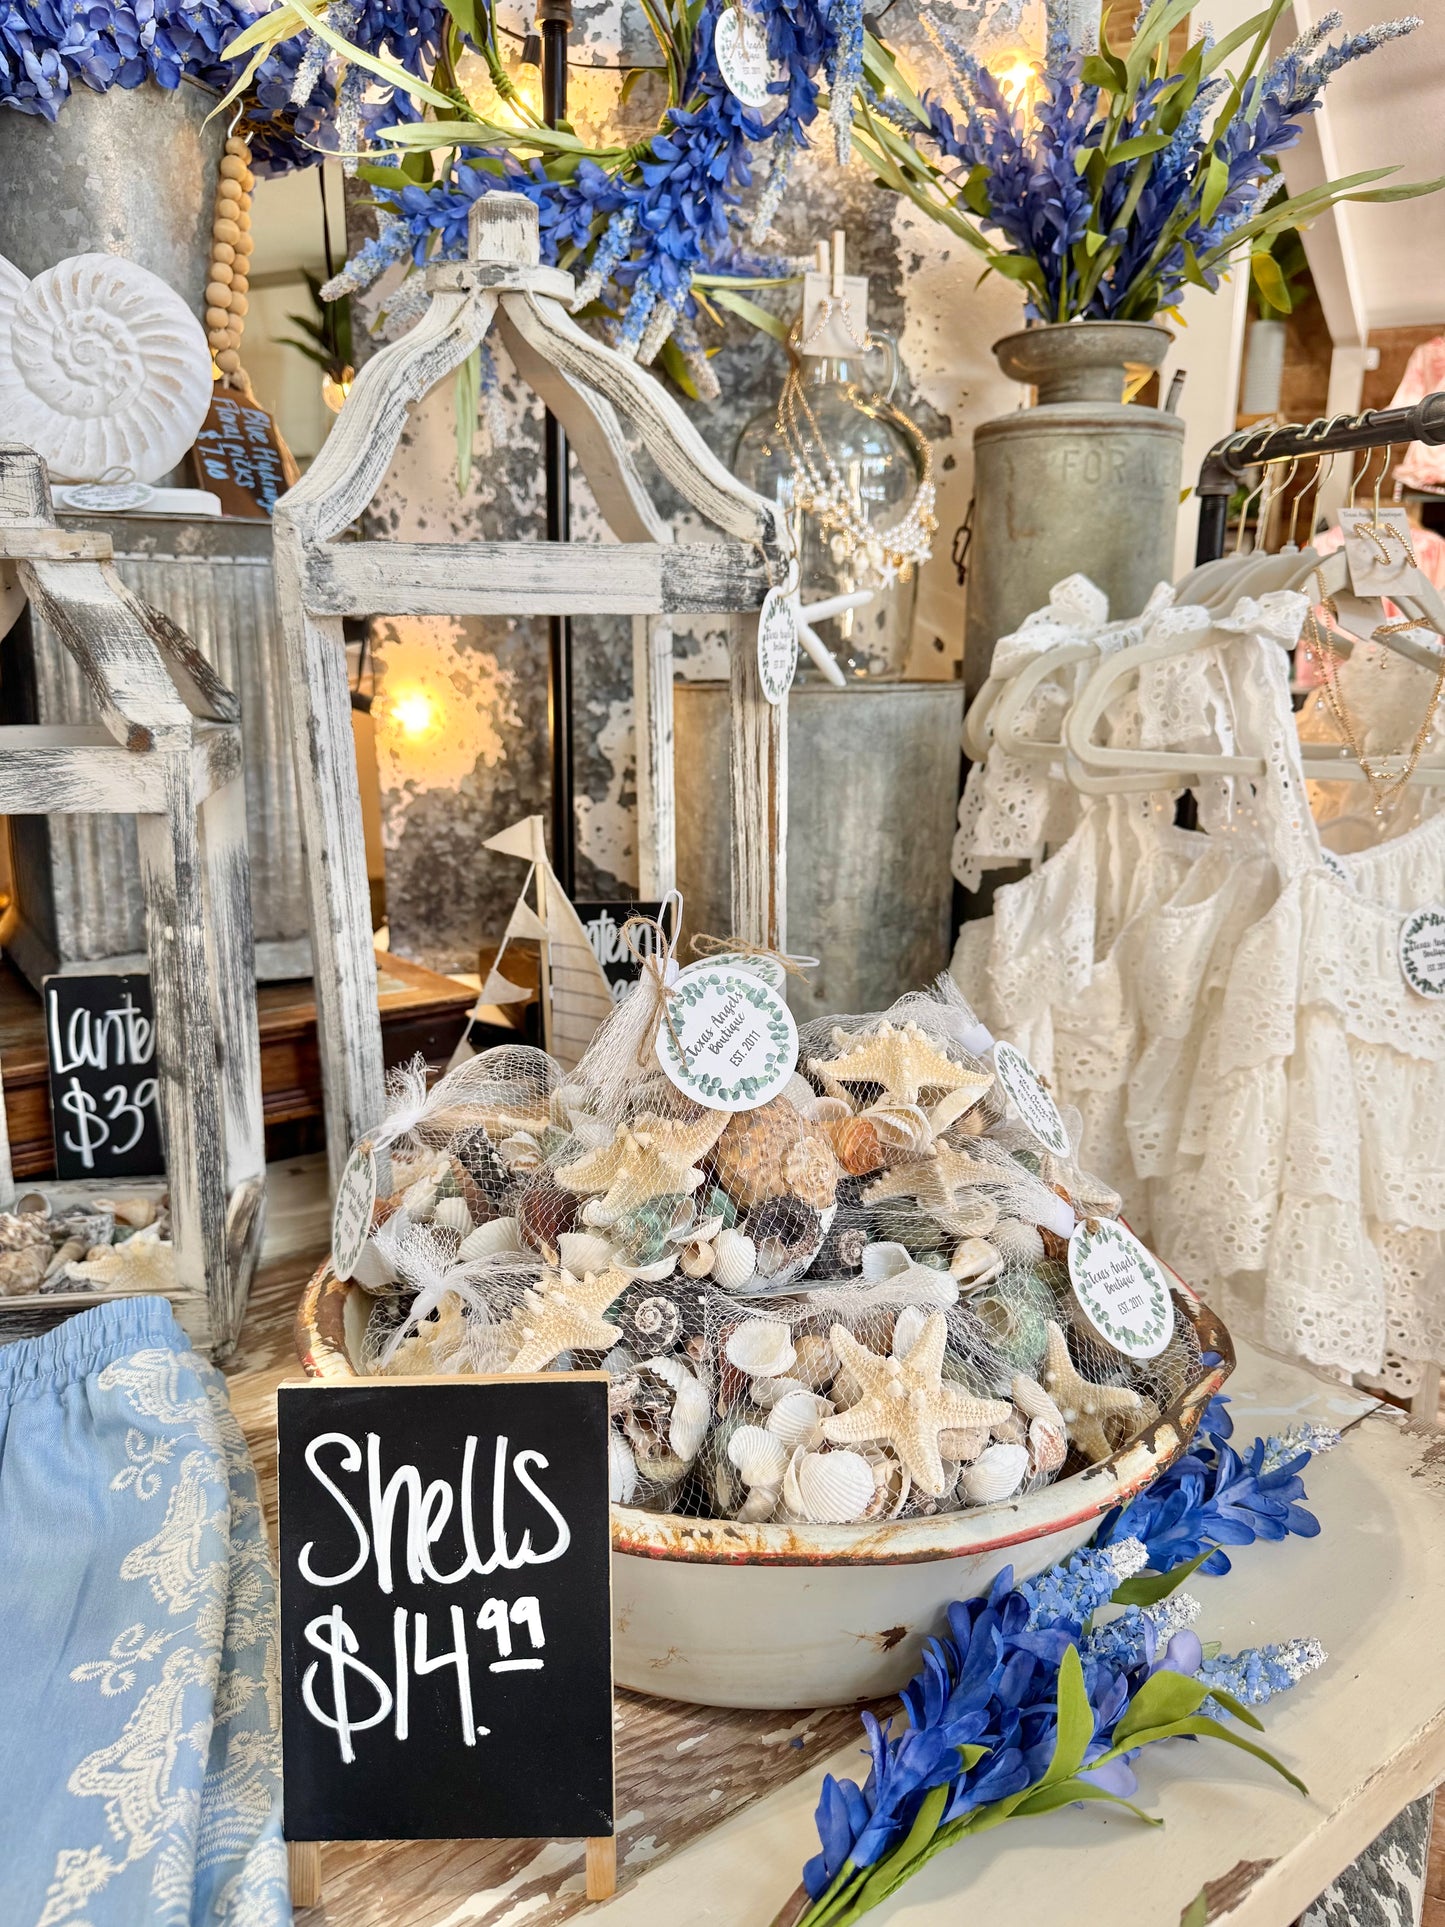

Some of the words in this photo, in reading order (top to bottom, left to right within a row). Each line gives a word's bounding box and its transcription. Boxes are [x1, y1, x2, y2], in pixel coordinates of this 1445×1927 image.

[211, 396, 245, 440] Floral
[241, 406, 271, 443] Blue
[49, 989, 157, 1074] Lante
[685, 1028, 714, 1058] Texas
[712, 991, 744, 1029] Angels
[708, 1011, 745, 1055] Boutique
[729, 1049, 747, 1067] EST.
[742, 1031, 761, 1051] 2011
[1087, 1268, 1110, 1285] Texas
[1110, 1254, 1137, 1275] Angels
[1103, 1274, 1136, 1295] Boutique
[1117, 1300, 1132, 1316] EST.
[1132, 1294, 1145, 1309] 2011
[299, 1432, 571, 1594] Shells
